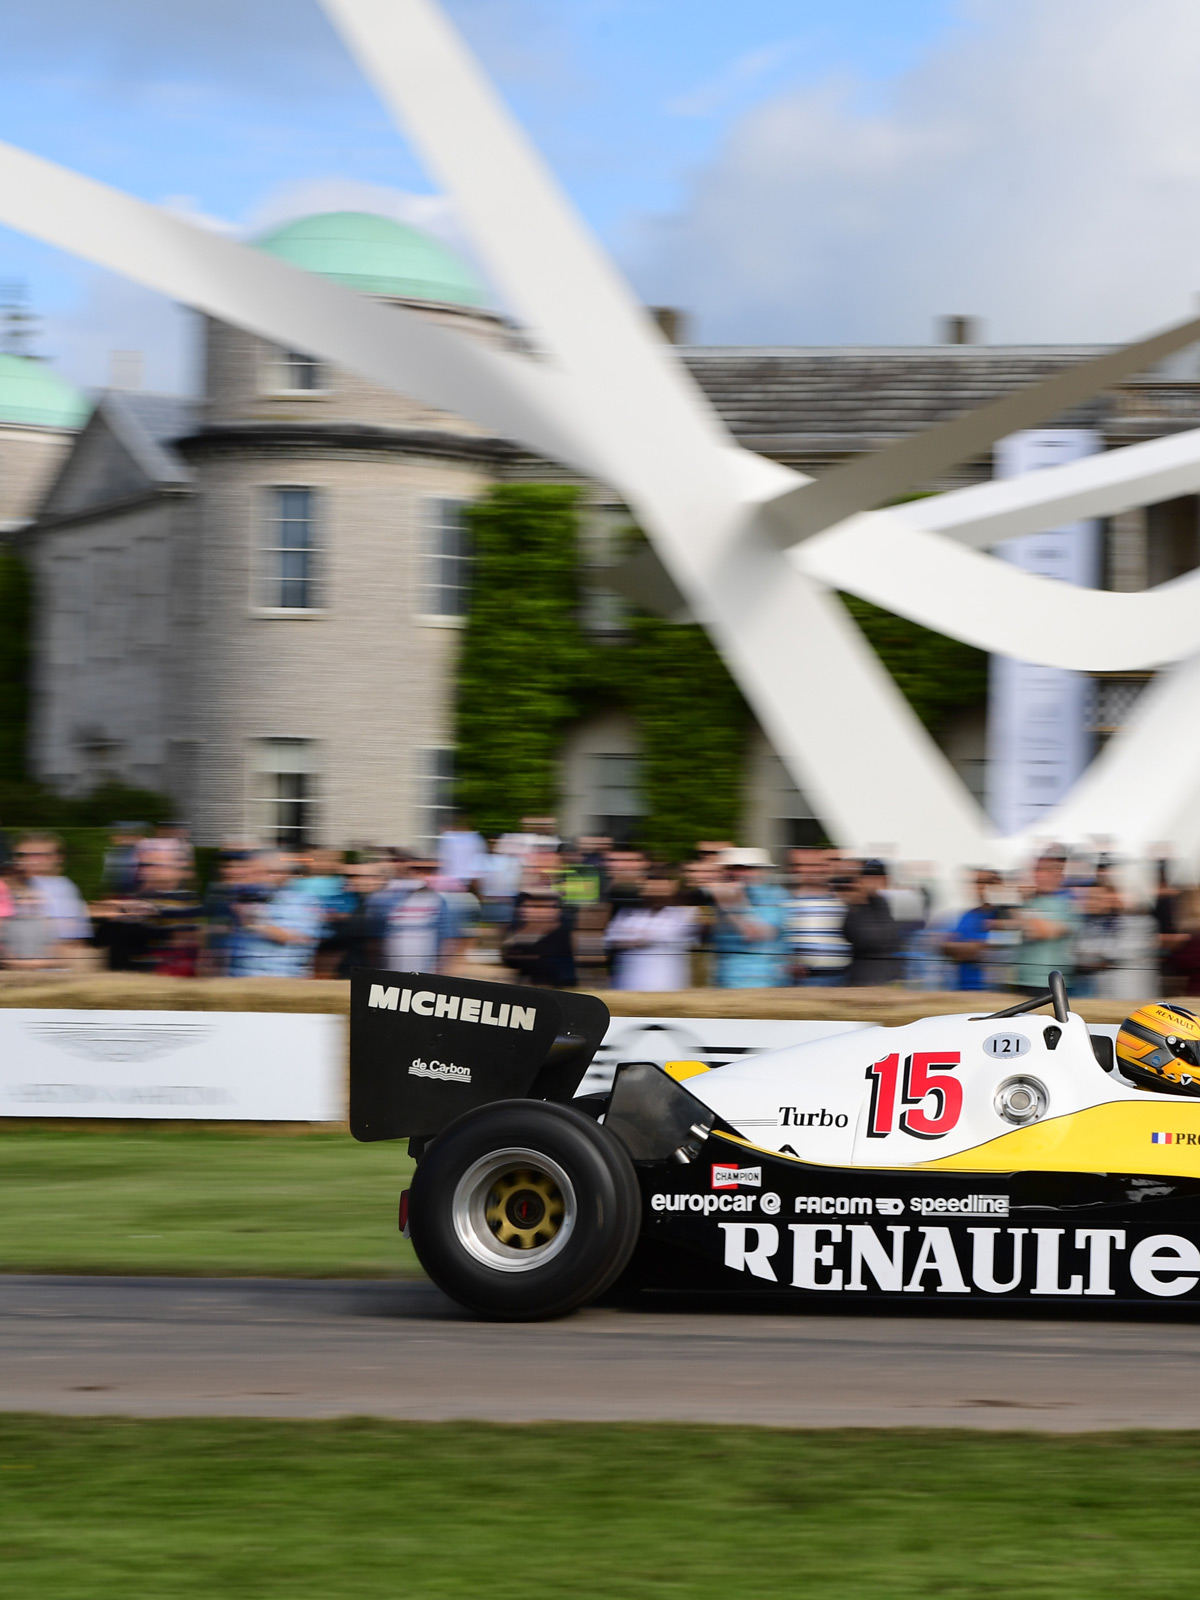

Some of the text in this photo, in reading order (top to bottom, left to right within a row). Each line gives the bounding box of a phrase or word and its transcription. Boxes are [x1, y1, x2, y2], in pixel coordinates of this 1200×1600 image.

[368, 984, 536, 1031] MICHELIN
[1155, 1009, 1196, 1031] RENAULT
[993, 1039, 1020, 1053] 121
[412, 1058, 471, 1076] de Carbon
[865, 1051, 963, 1140] 15
[778, 1107, 849, 1129] Turbo
[715, 1171, 760, 1182] CHAMPION
[651, 1193, 757, 1216] europcar
[909, 1195, 1010, 1216] speedline
[717, 1222, 1127, 1296] RENAULT
